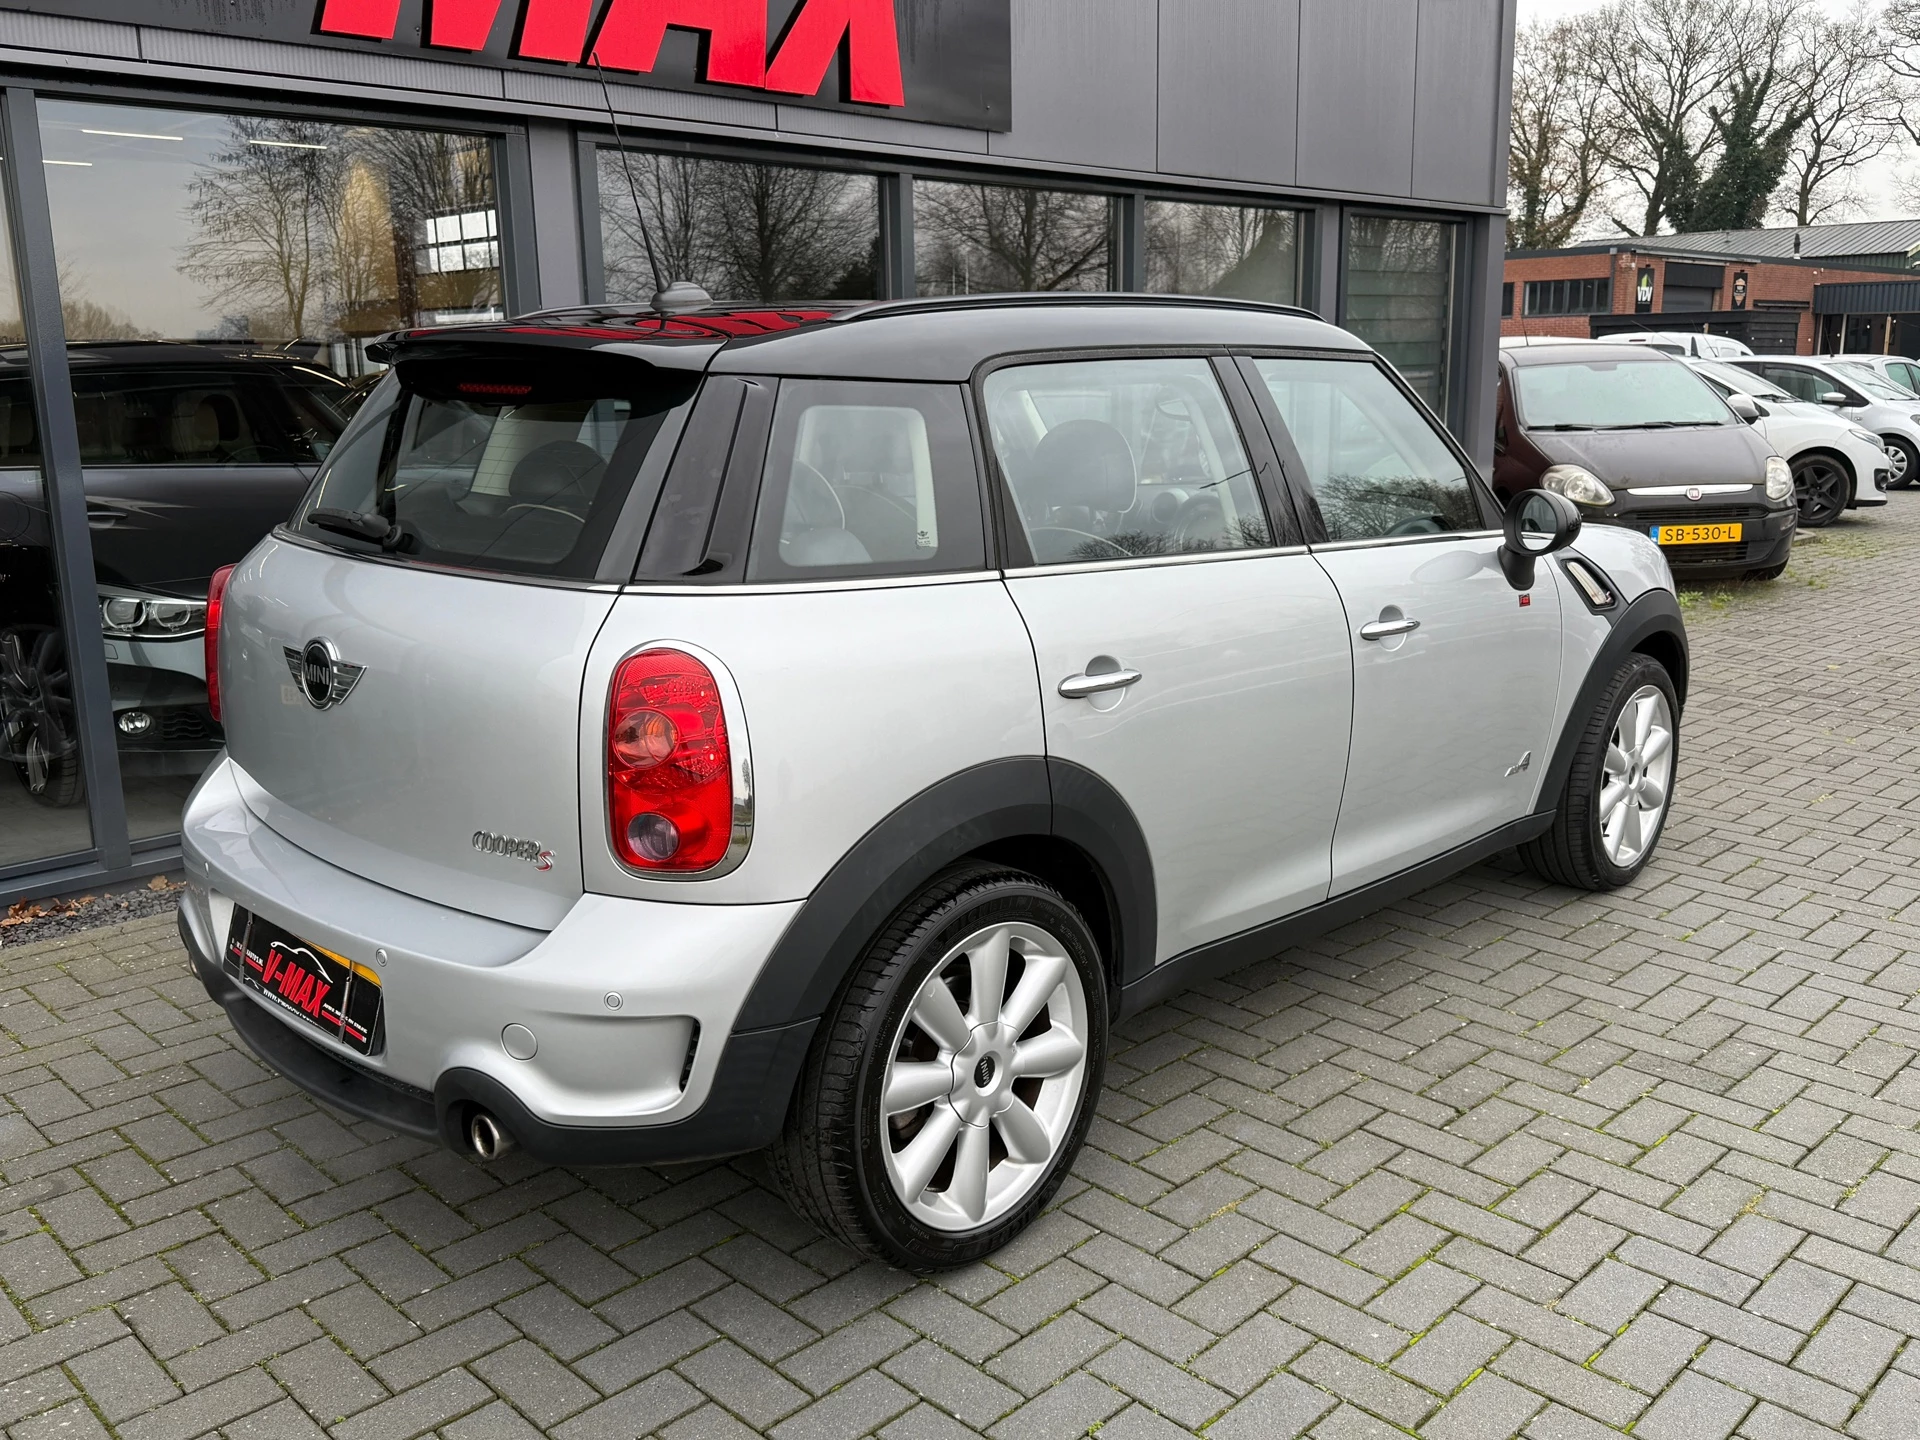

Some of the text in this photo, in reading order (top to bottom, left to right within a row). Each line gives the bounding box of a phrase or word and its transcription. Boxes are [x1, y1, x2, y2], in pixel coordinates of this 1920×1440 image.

[1665, 527, 1735, 542] SB-530-L
[304, 662, 330, 686] MINI
[471, 830, 556, 872] COOPER S
[262, 948, 331, 1018] V-MAX
